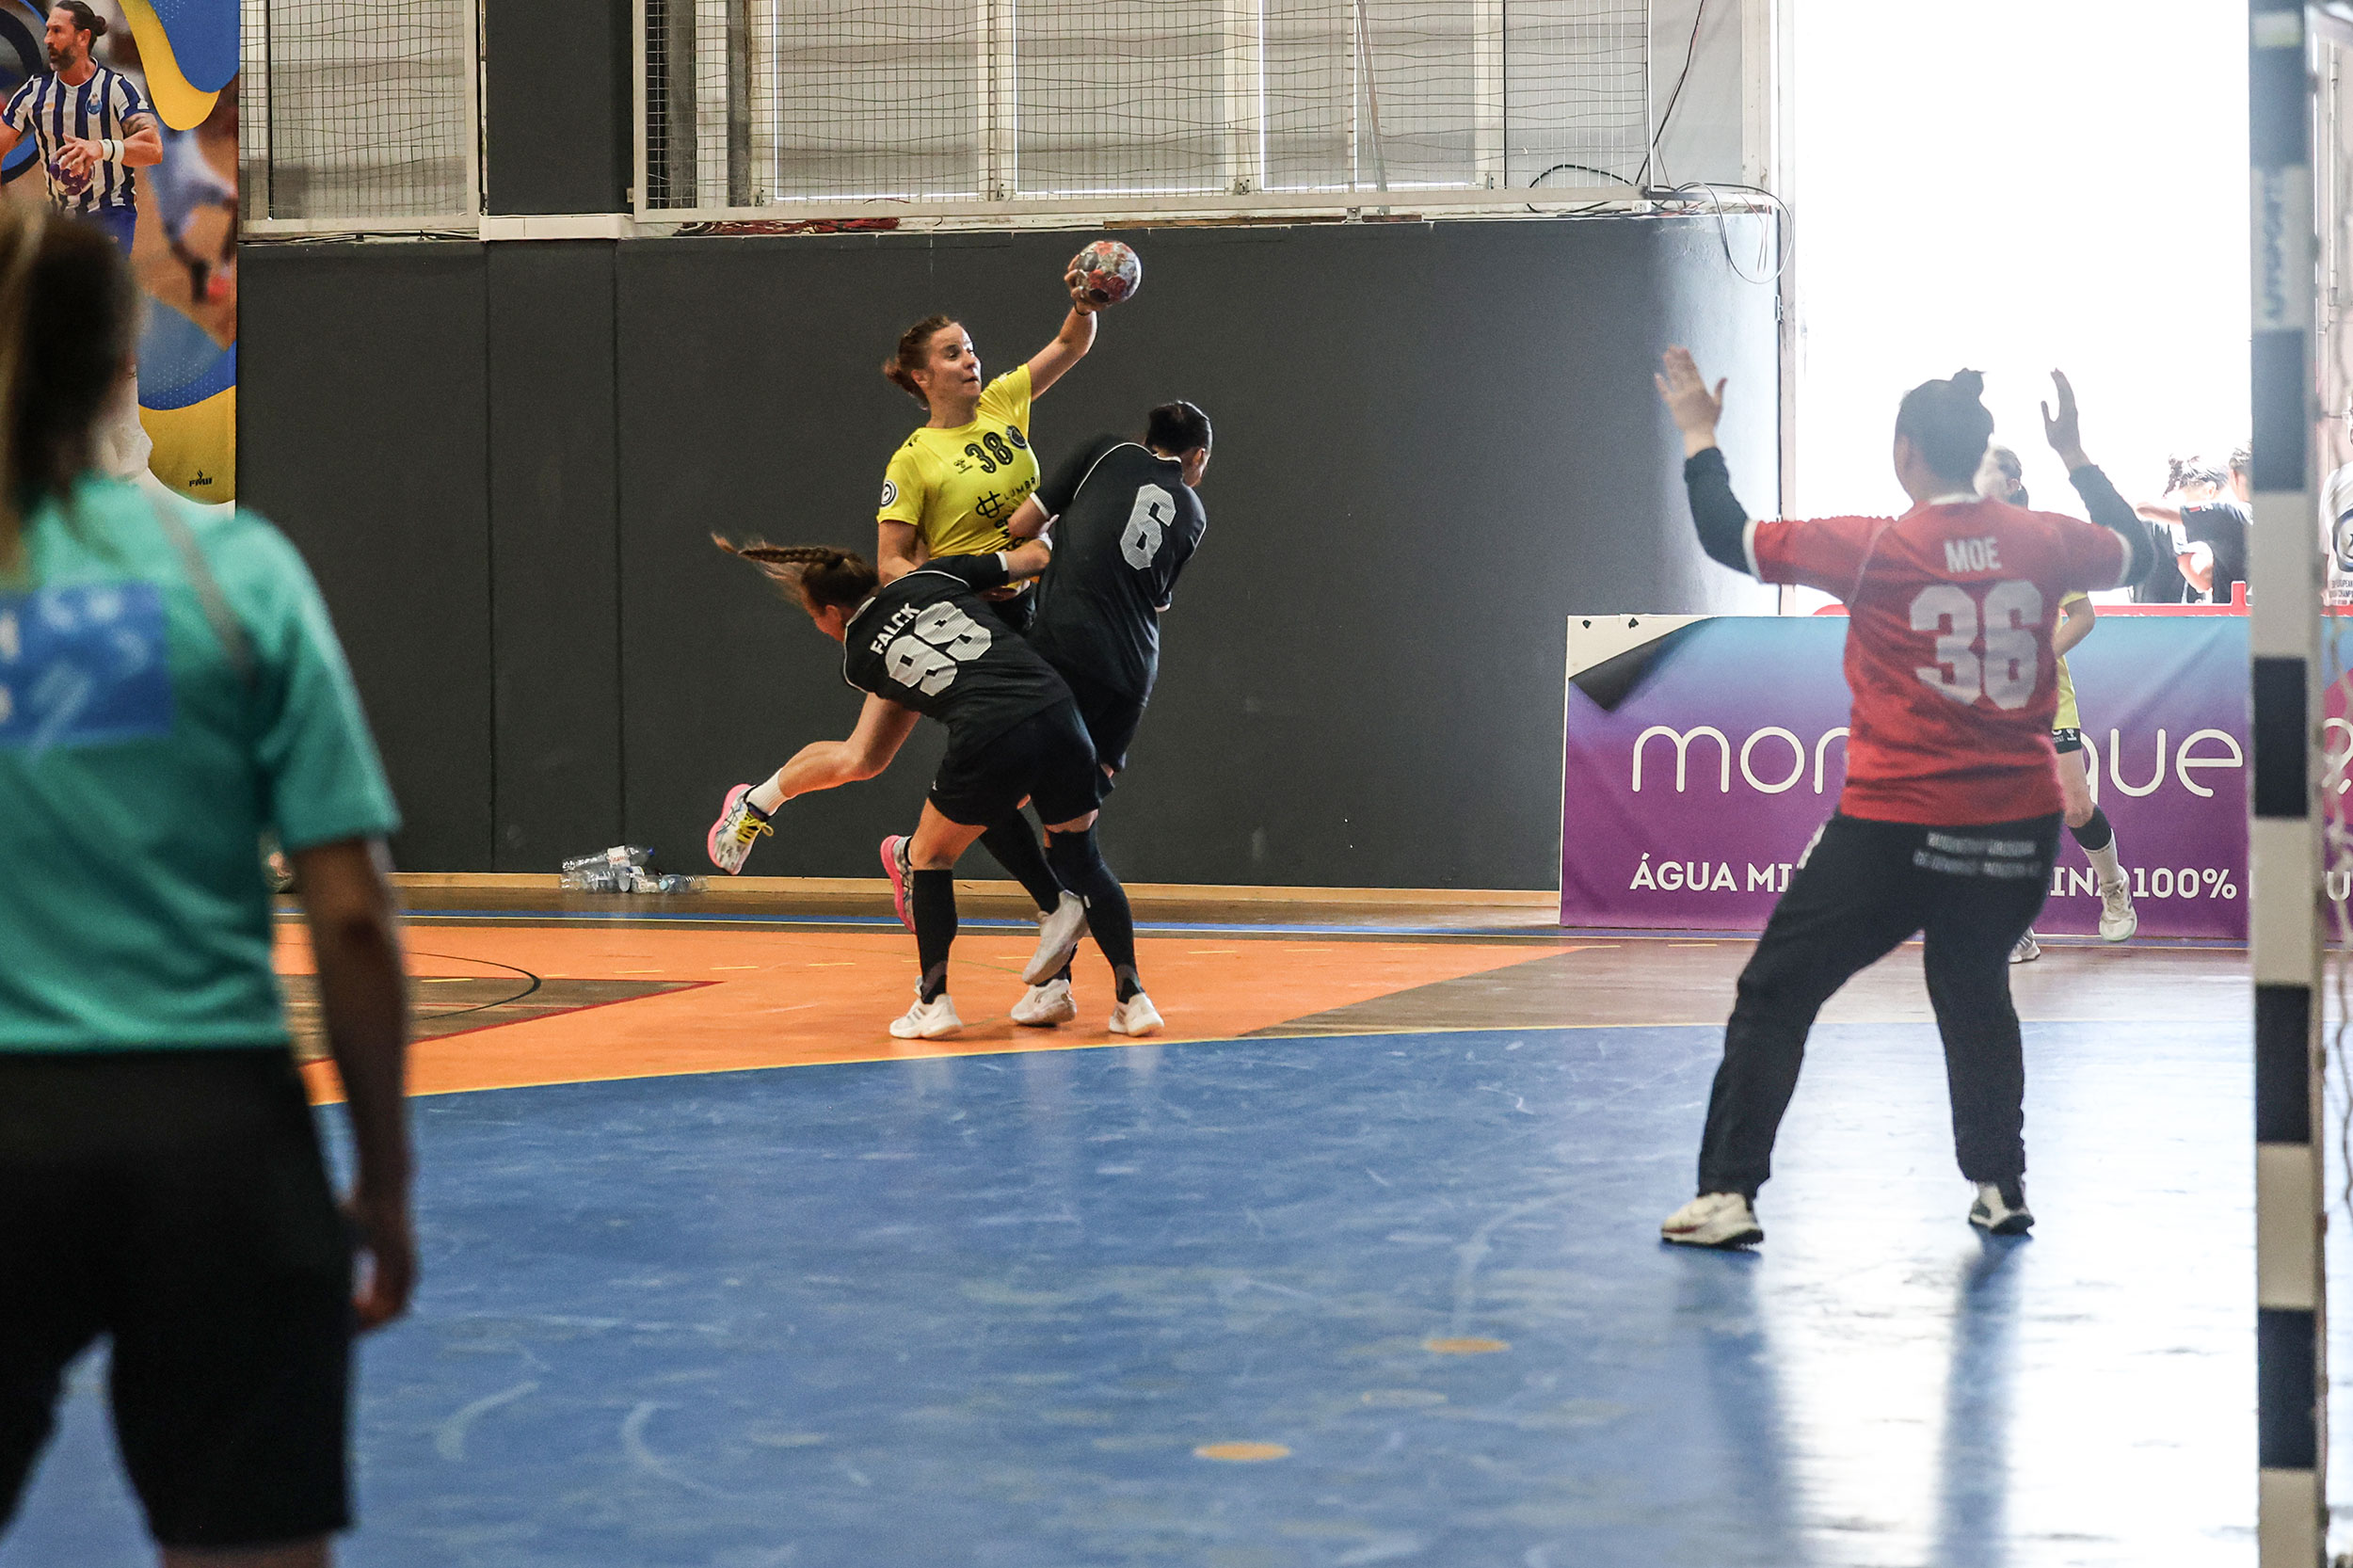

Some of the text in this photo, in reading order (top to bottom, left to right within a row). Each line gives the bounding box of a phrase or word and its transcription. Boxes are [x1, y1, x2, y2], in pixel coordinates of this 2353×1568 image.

[964, 431, 1015, 474] 38
[1119, 483, 1177, 571] 6
[1944, 536, 2003, 573] MOE
[869, 602, 921, 656] FALCK
[885, 600, 993, 698] 99
[1909, 579, 2044, 711] 36
[1629, 851, 1738, 892] ÁGUA
[2133, 867, 2238, 901] 100%
